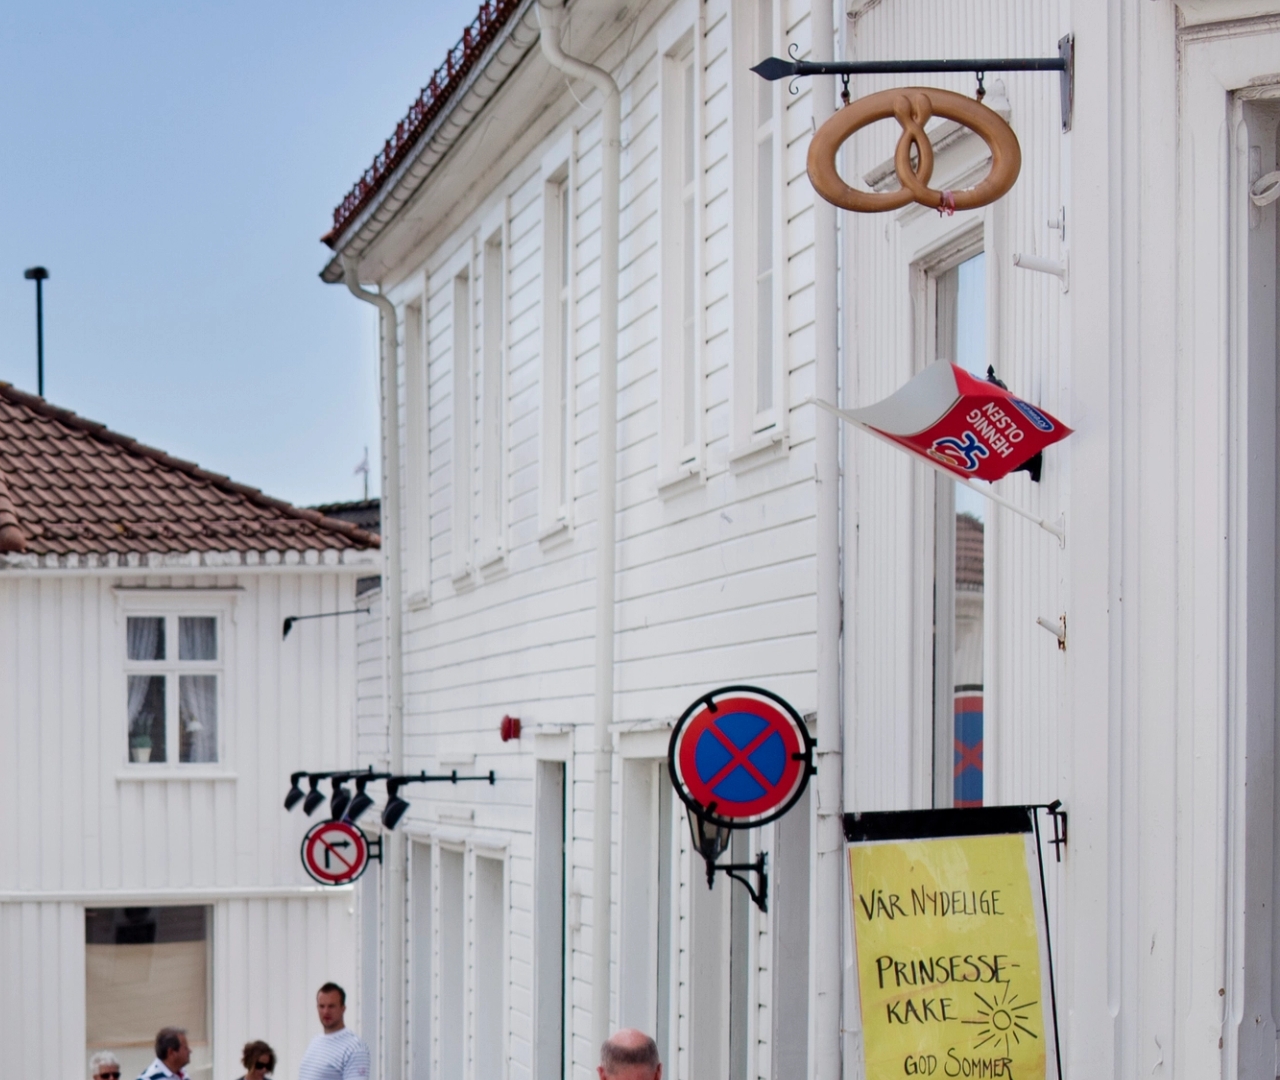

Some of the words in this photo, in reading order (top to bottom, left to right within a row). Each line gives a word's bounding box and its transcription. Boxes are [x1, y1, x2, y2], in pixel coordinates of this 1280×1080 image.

[966, 409, 1014, 458] HENNIG
[982, 402, 1024, 442] OLSEN
[860, 889, 909, 921] VÅR
[911, 885, 1004, 917] NYDELIGE
[876, 954, 1020, 989] PRINSESSE-
[887, 998, 958, 1024] KAKE
[904, 1054, 937, 1077] GOD
